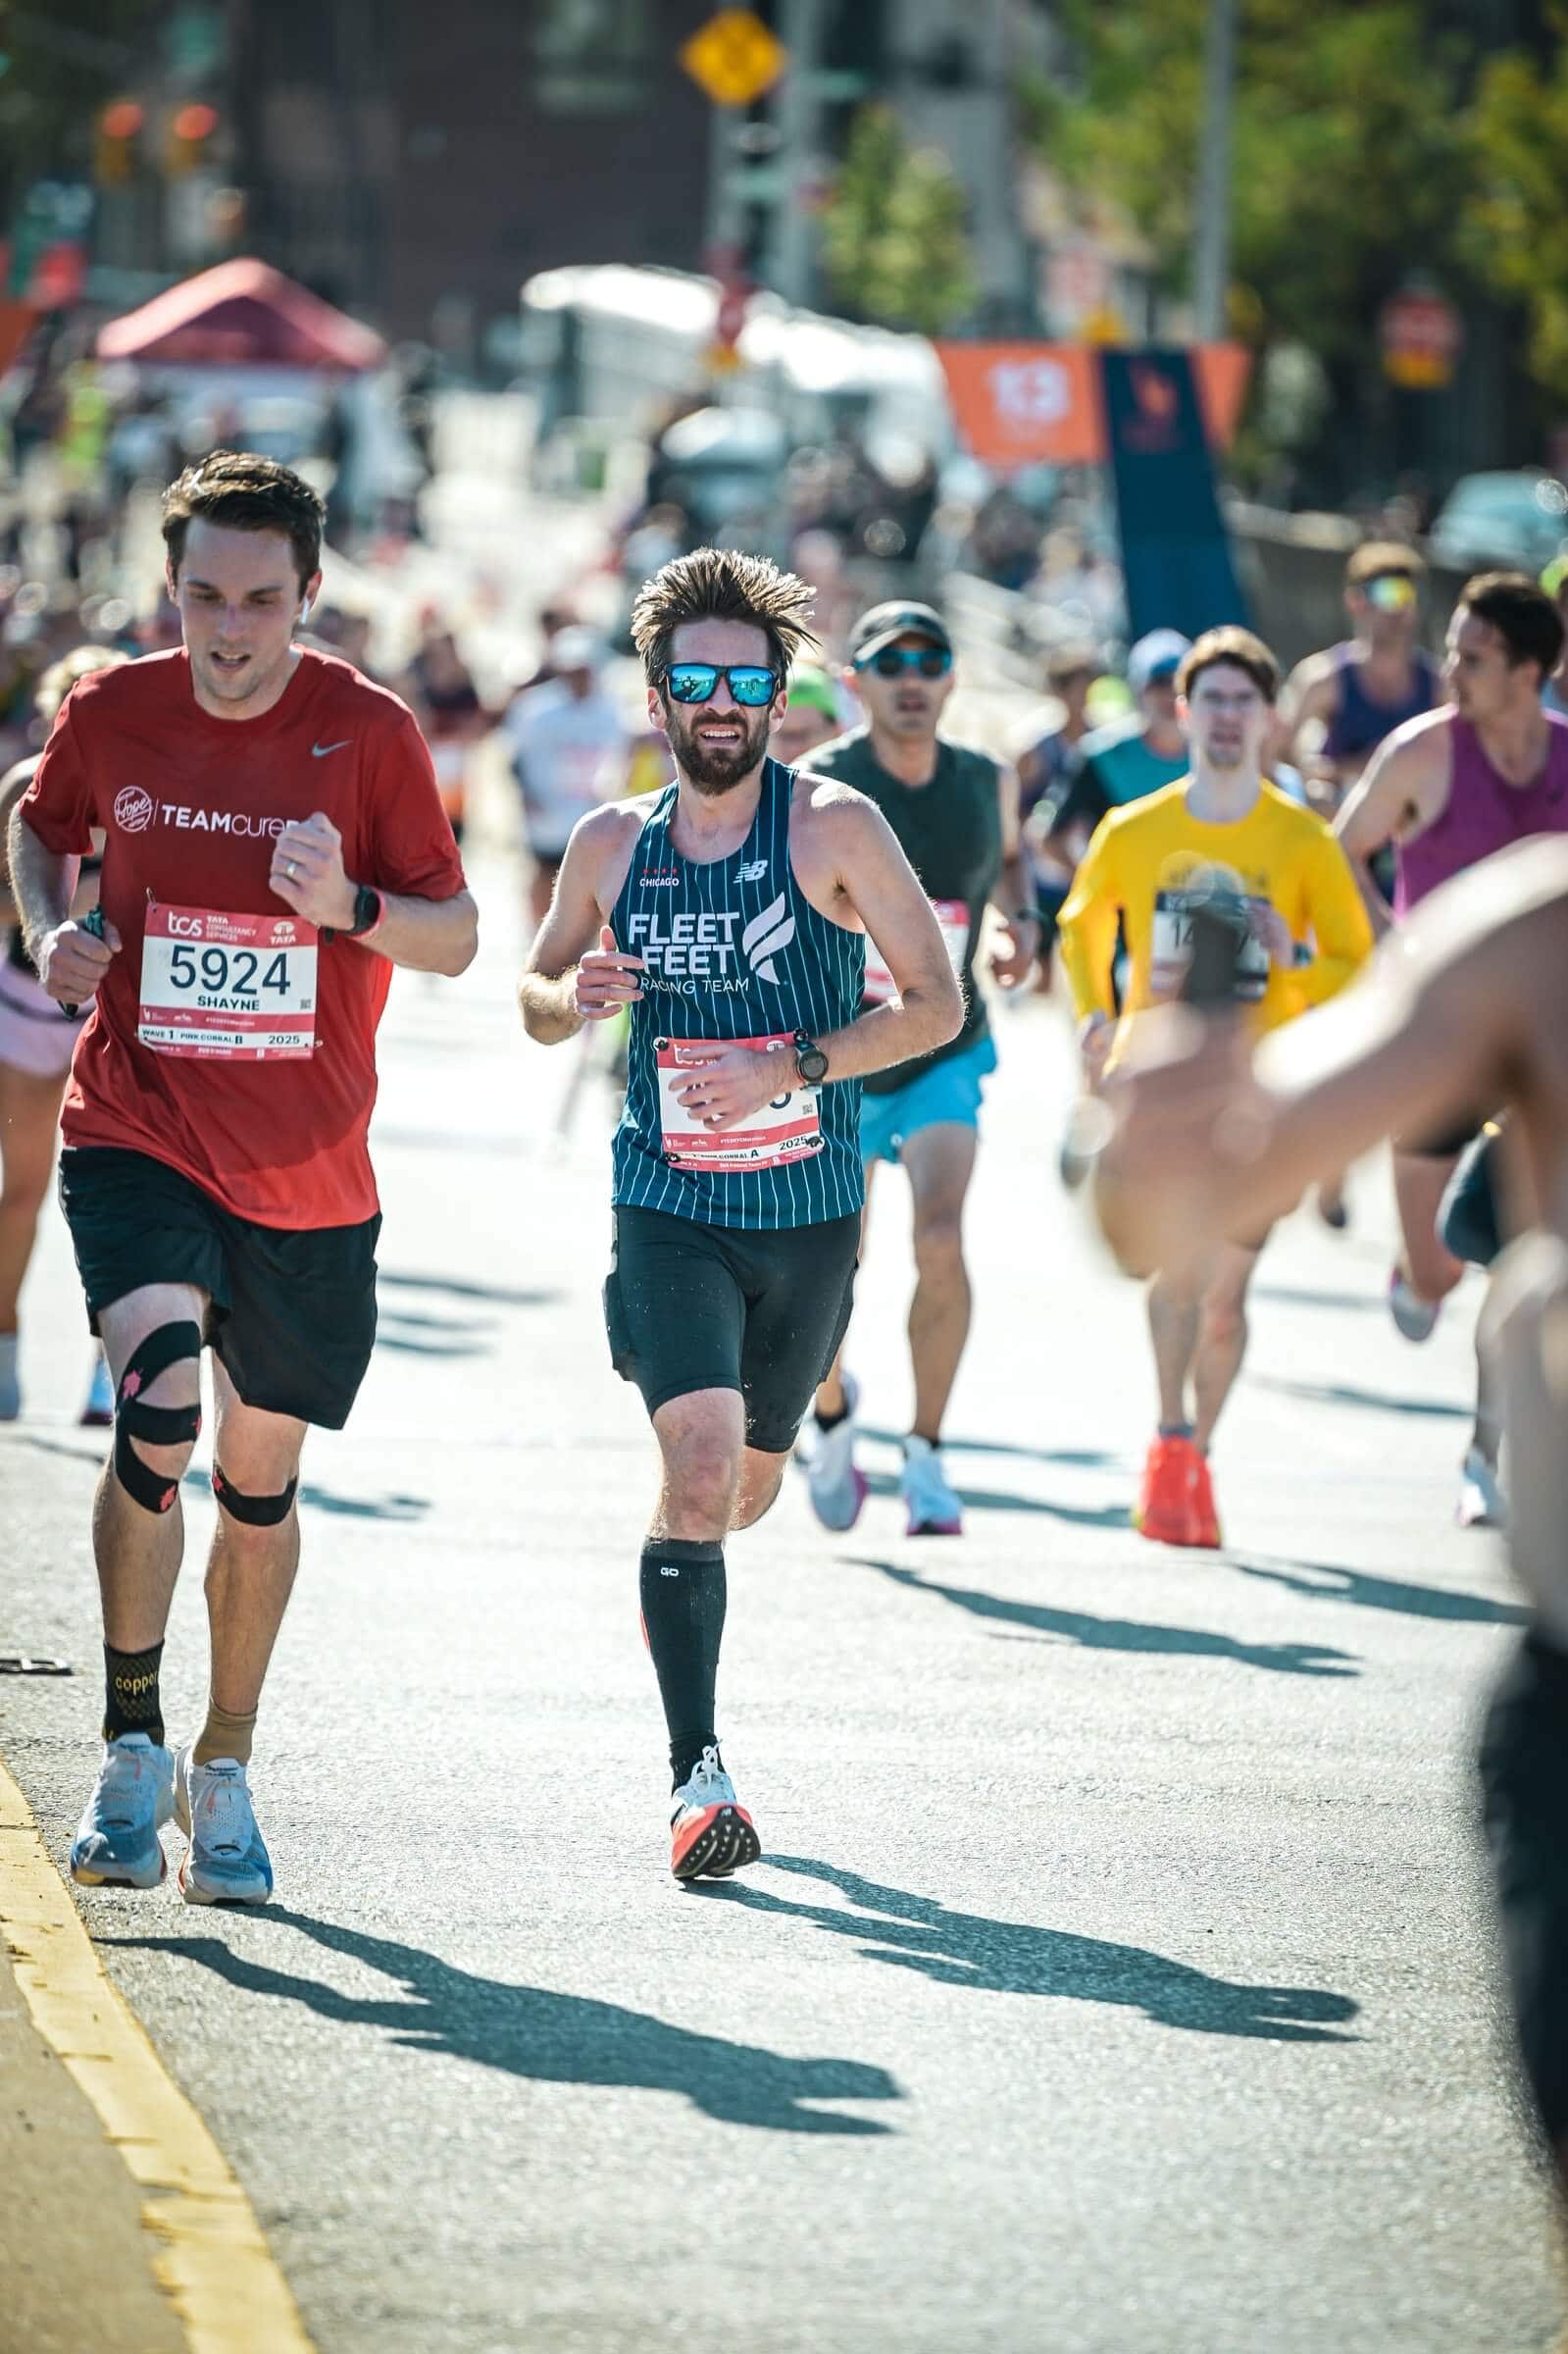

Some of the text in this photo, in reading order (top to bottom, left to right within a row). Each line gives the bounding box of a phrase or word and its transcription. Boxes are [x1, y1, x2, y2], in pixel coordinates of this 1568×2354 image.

[639, 878, 680, 887] CHICAGO
[168, 910, 203, 938] tcs
[629, 912, 740, 945] FLEET
[270, 935, 297, 945] TATA
[642, 944, 735, 975] FEET
[170, 945, 291, 996] 5924
[639, 977, 749, 995] RACING TEAM
[197, 996, 260, 1011] SHAYNE
[169, 1030, 175, 1040] 1
[269, 1035, 300, 1045] 2025
[779, 1136, 807, 1151] 2025
[750, 1150, 759, 1158] A
[660, 1567, 680, 1576] GO
